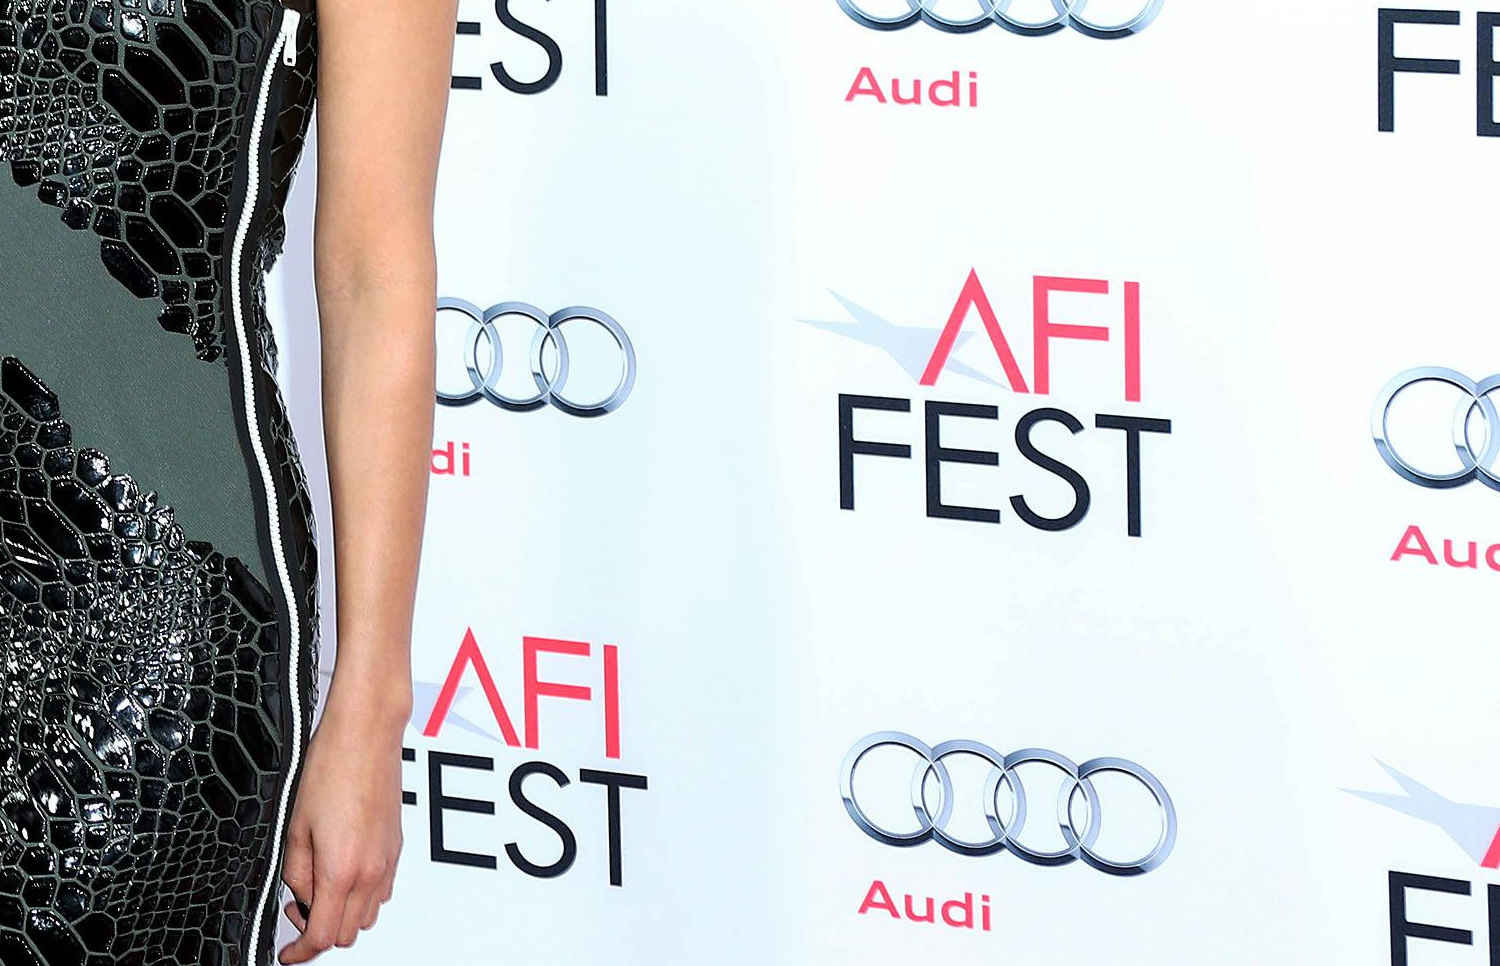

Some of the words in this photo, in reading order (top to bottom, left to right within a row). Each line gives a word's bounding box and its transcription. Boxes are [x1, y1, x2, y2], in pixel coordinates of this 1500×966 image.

[845, 66, 978, 108] Audi
[919, 268, 1141, 402] AFI
[430, 441, 470, 477] di
[838, 393, 1172, 538] FEST
[1390, 525, 1500, 572] Au
[422, 627, 621, 759] AFI
[401, 747, 648, 887] EST
[857, 879, 992, 932] Audi
